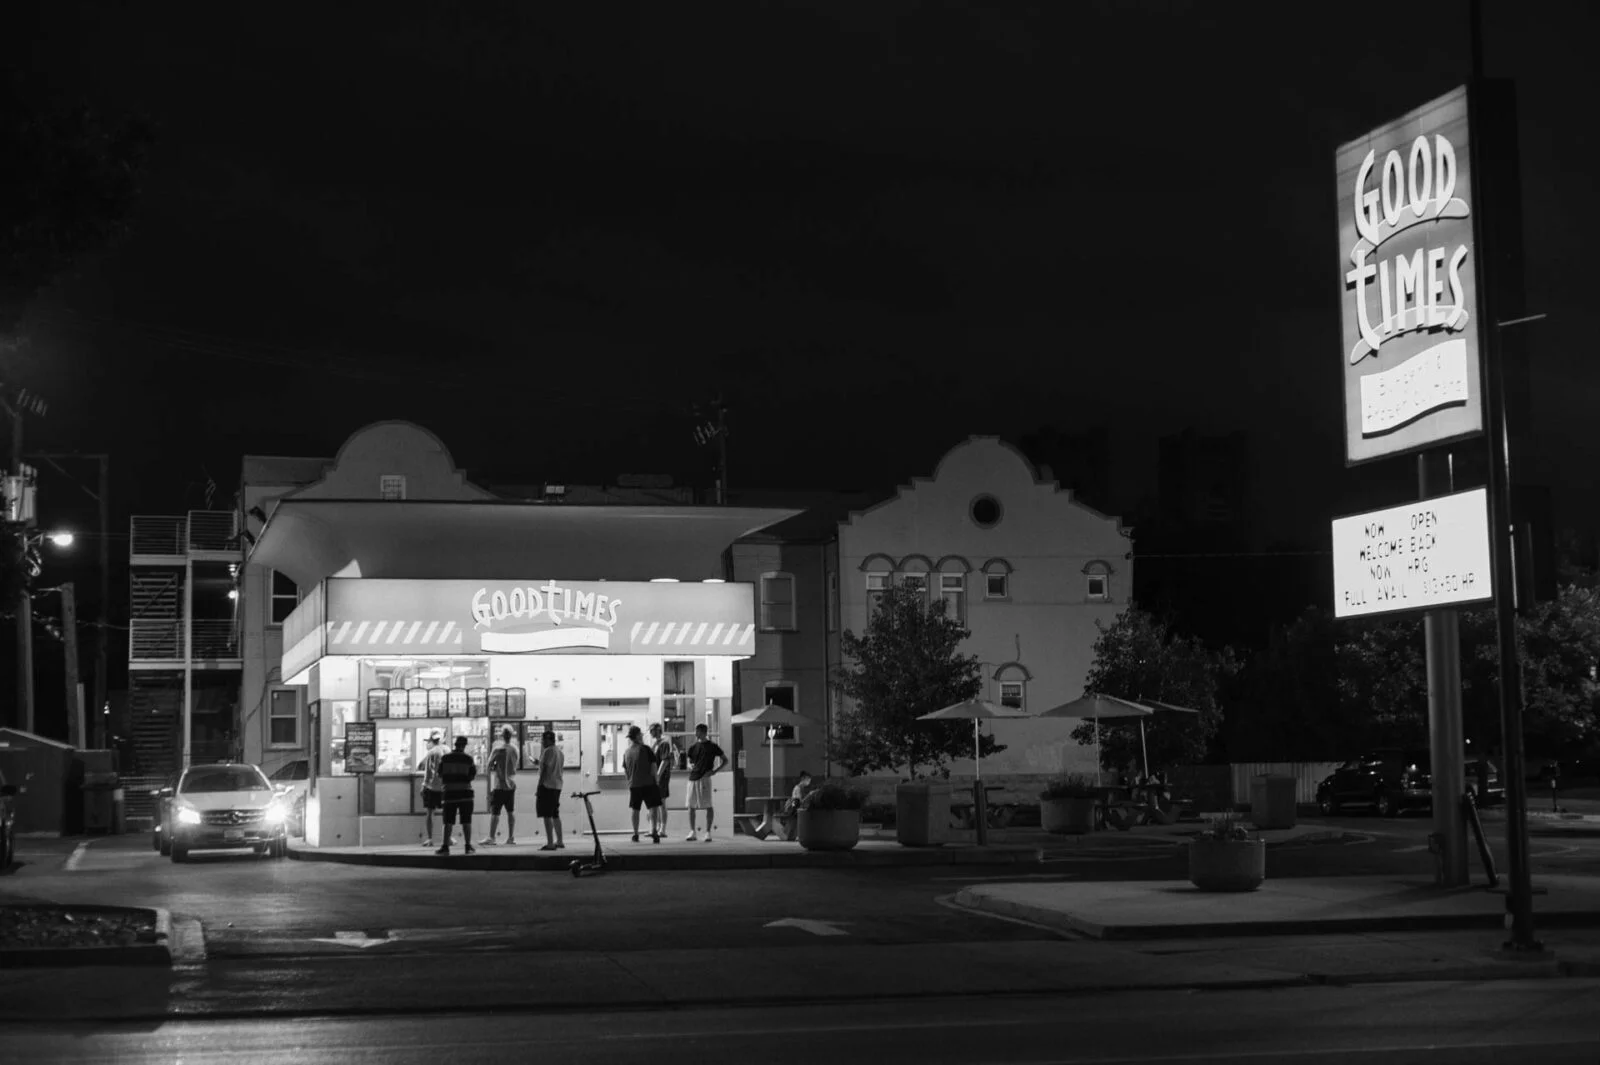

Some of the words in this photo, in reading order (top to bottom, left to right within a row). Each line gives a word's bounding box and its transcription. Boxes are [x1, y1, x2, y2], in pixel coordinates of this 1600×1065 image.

[1355, 134, 1456, 246] GOOD
[1364, 521, 1385, 539] NOW
[1410, 510, 1438, 531] OPEN
[1359, 538, 1404, 561] WELCOME
[1410, 533, 1437, 553] BACK
[1370, 564, 1391, 581] NOW
[1345, 589, 1367, 607] FULL
